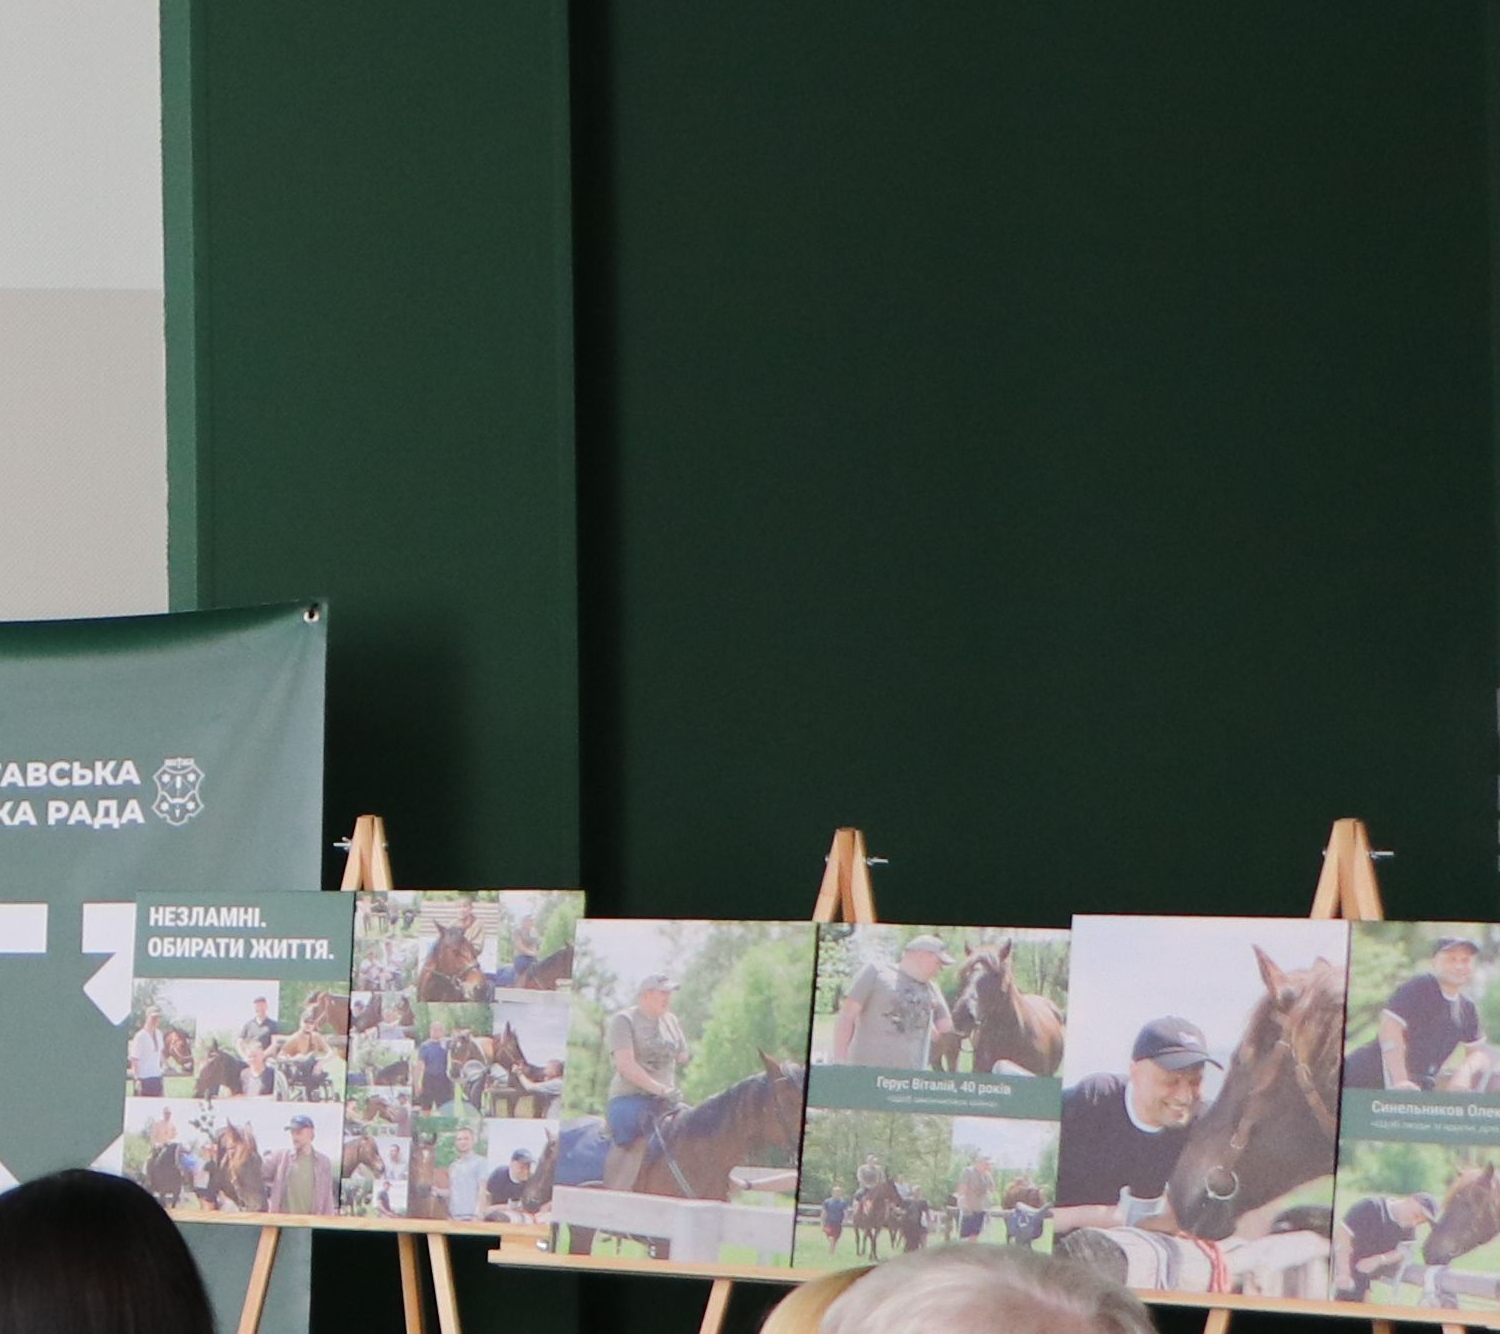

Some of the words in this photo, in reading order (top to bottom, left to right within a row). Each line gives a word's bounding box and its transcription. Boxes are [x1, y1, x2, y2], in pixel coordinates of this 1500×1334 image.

[45, 799, 146, 831] РАДА
[148, 905, 267, 929] НЕЗЛАМНІ.
[147, 937, 245, 959] ОБИРАТИ
[249, 938, 335, 961] ЖИТТЯ.
[876, 1075, 910, 1090] Герус
[911, 1077, 958, 1094] Віталій,
[960, 1079, 976, 1094] 40
[978, 1080, 1012, 1095] років
[1371, 1099, 1464, 1116] Синельников
